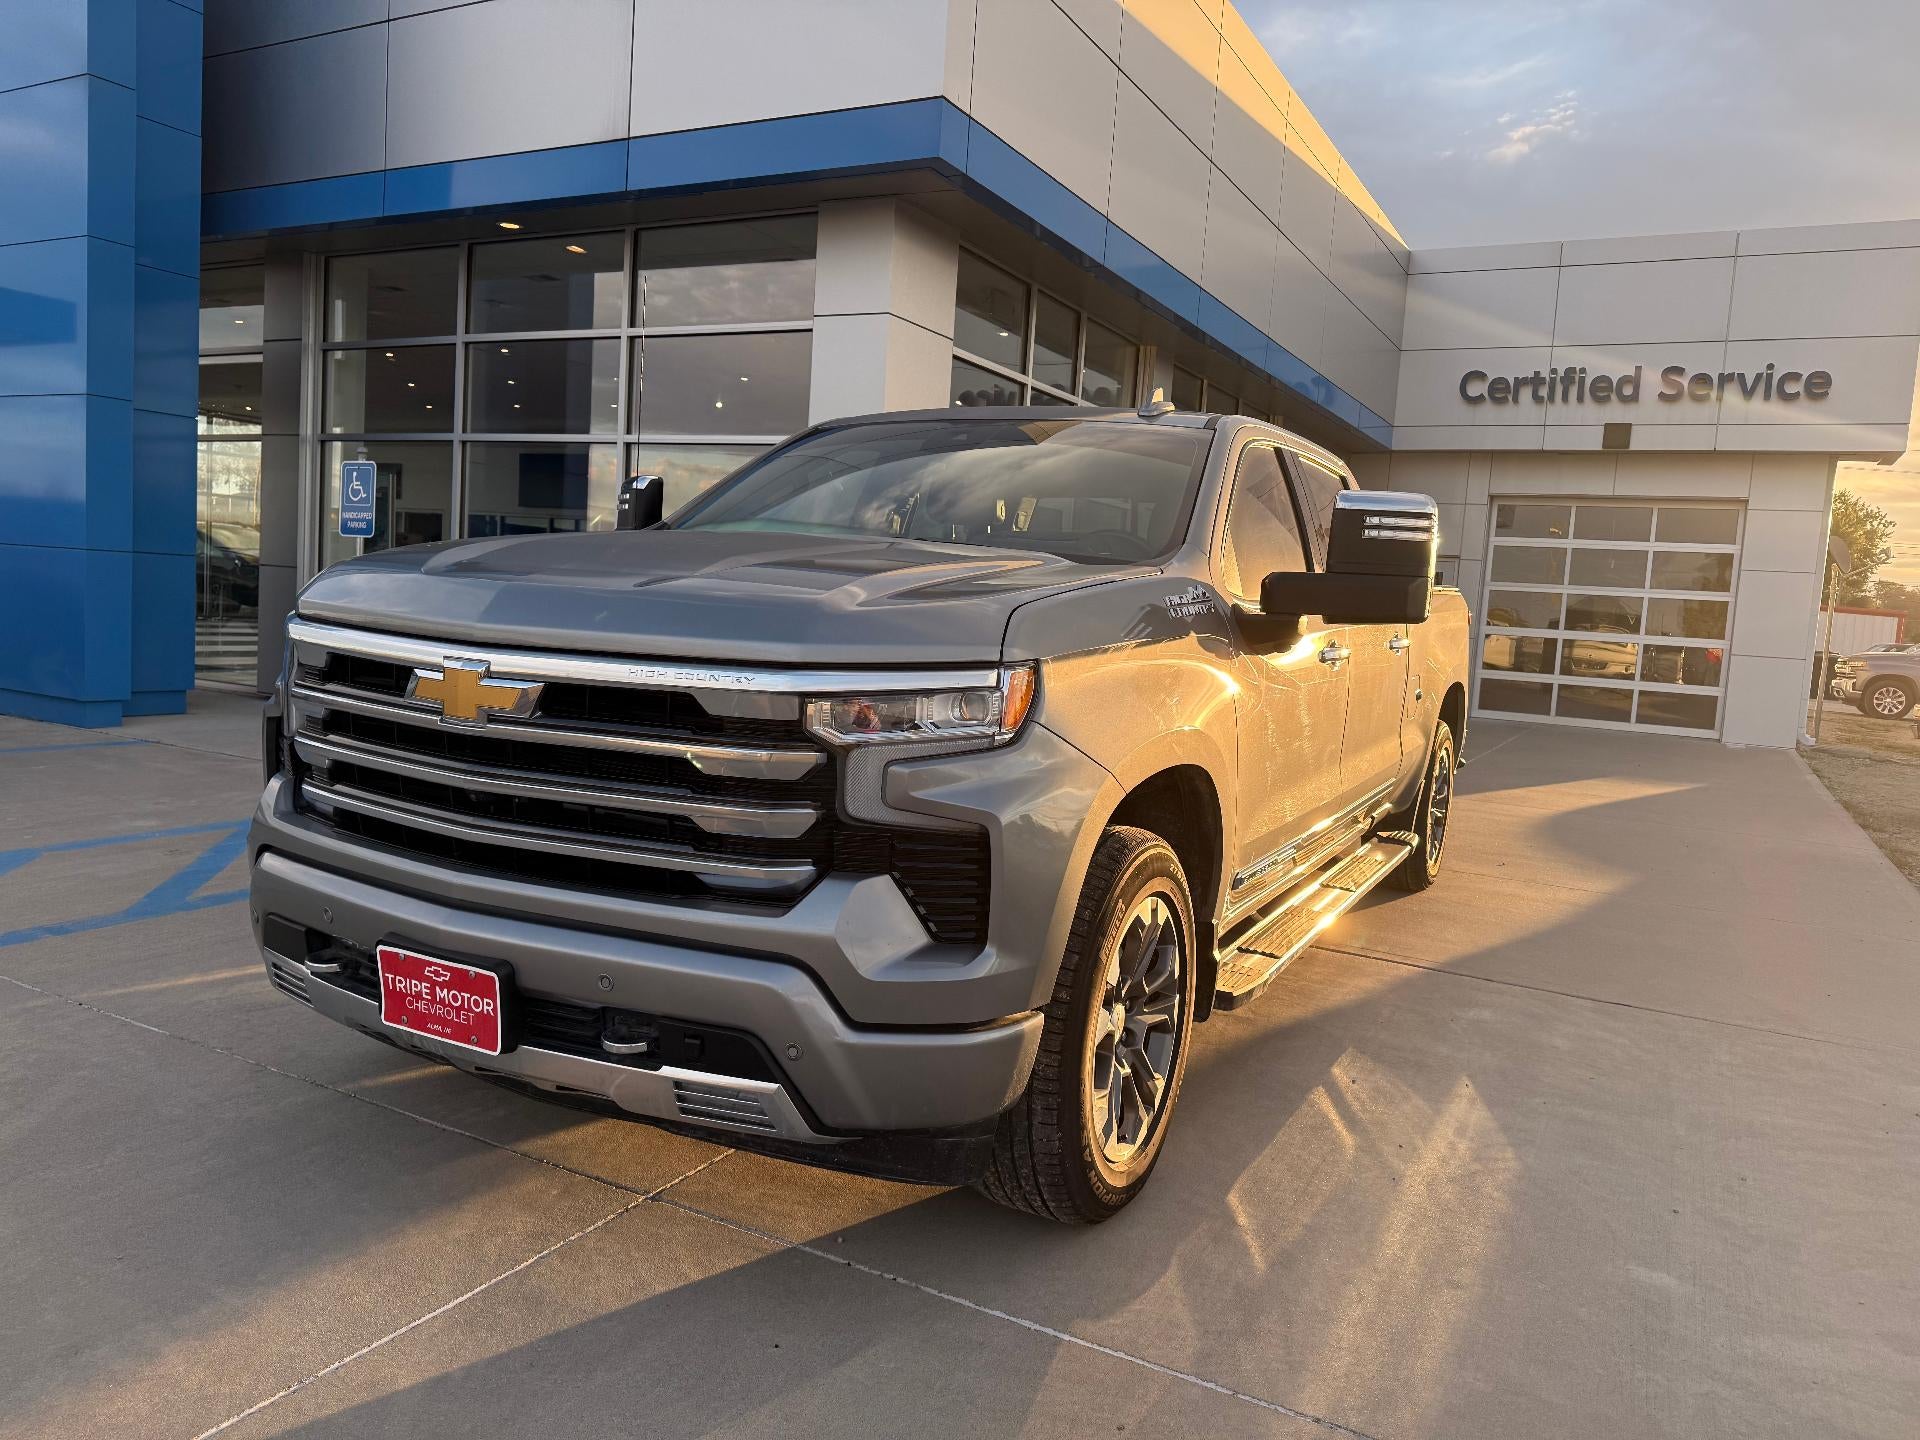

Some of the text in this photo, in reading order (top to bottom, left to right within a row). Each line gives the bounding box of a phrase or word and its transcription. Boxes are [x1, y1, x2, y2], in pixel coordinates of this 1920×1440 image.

[1459, 362, 1833, 404] Certified Service
[347, 521, 367, 529] PARKING
[627, 667, 756, 685] HIGH COUNTRY
[384, 973, 495, 1017] TRIPE MOTOR
[405, 996, 475, 1026] CHEVROLET
